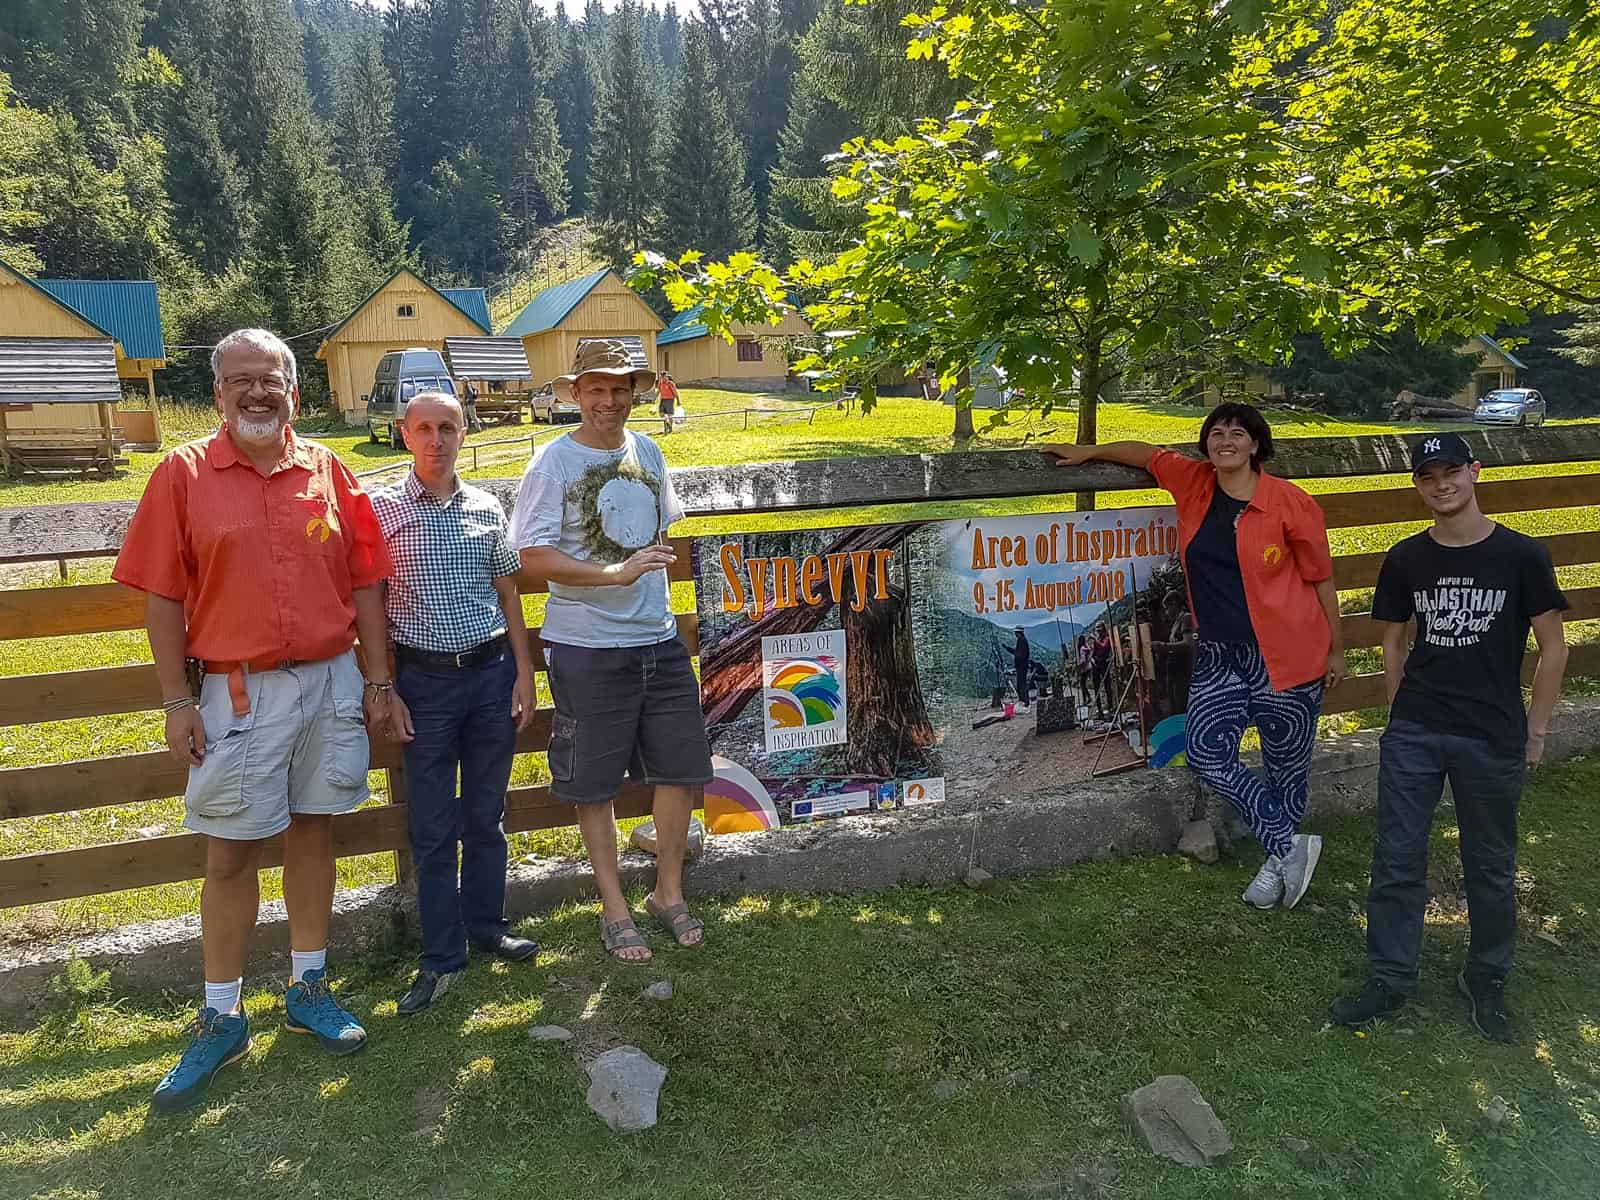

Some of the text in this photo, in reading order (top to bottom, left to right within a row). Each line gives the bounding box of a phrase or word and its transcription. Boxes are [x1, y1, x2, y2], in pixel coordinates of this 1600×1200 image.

[971, 517, 1180, 570] Area of Inspiratio
[719, 543, 894, 621] Synevyr
[1023, 576, 1083, 612] August
[1087, 570, 1126, 604] 2018
[1413, 587, 1507, 613] RAJASTHAN
[771, 634, 833, 655] AREAS OF
[773, 727, 841, 750] INSPIRATION
